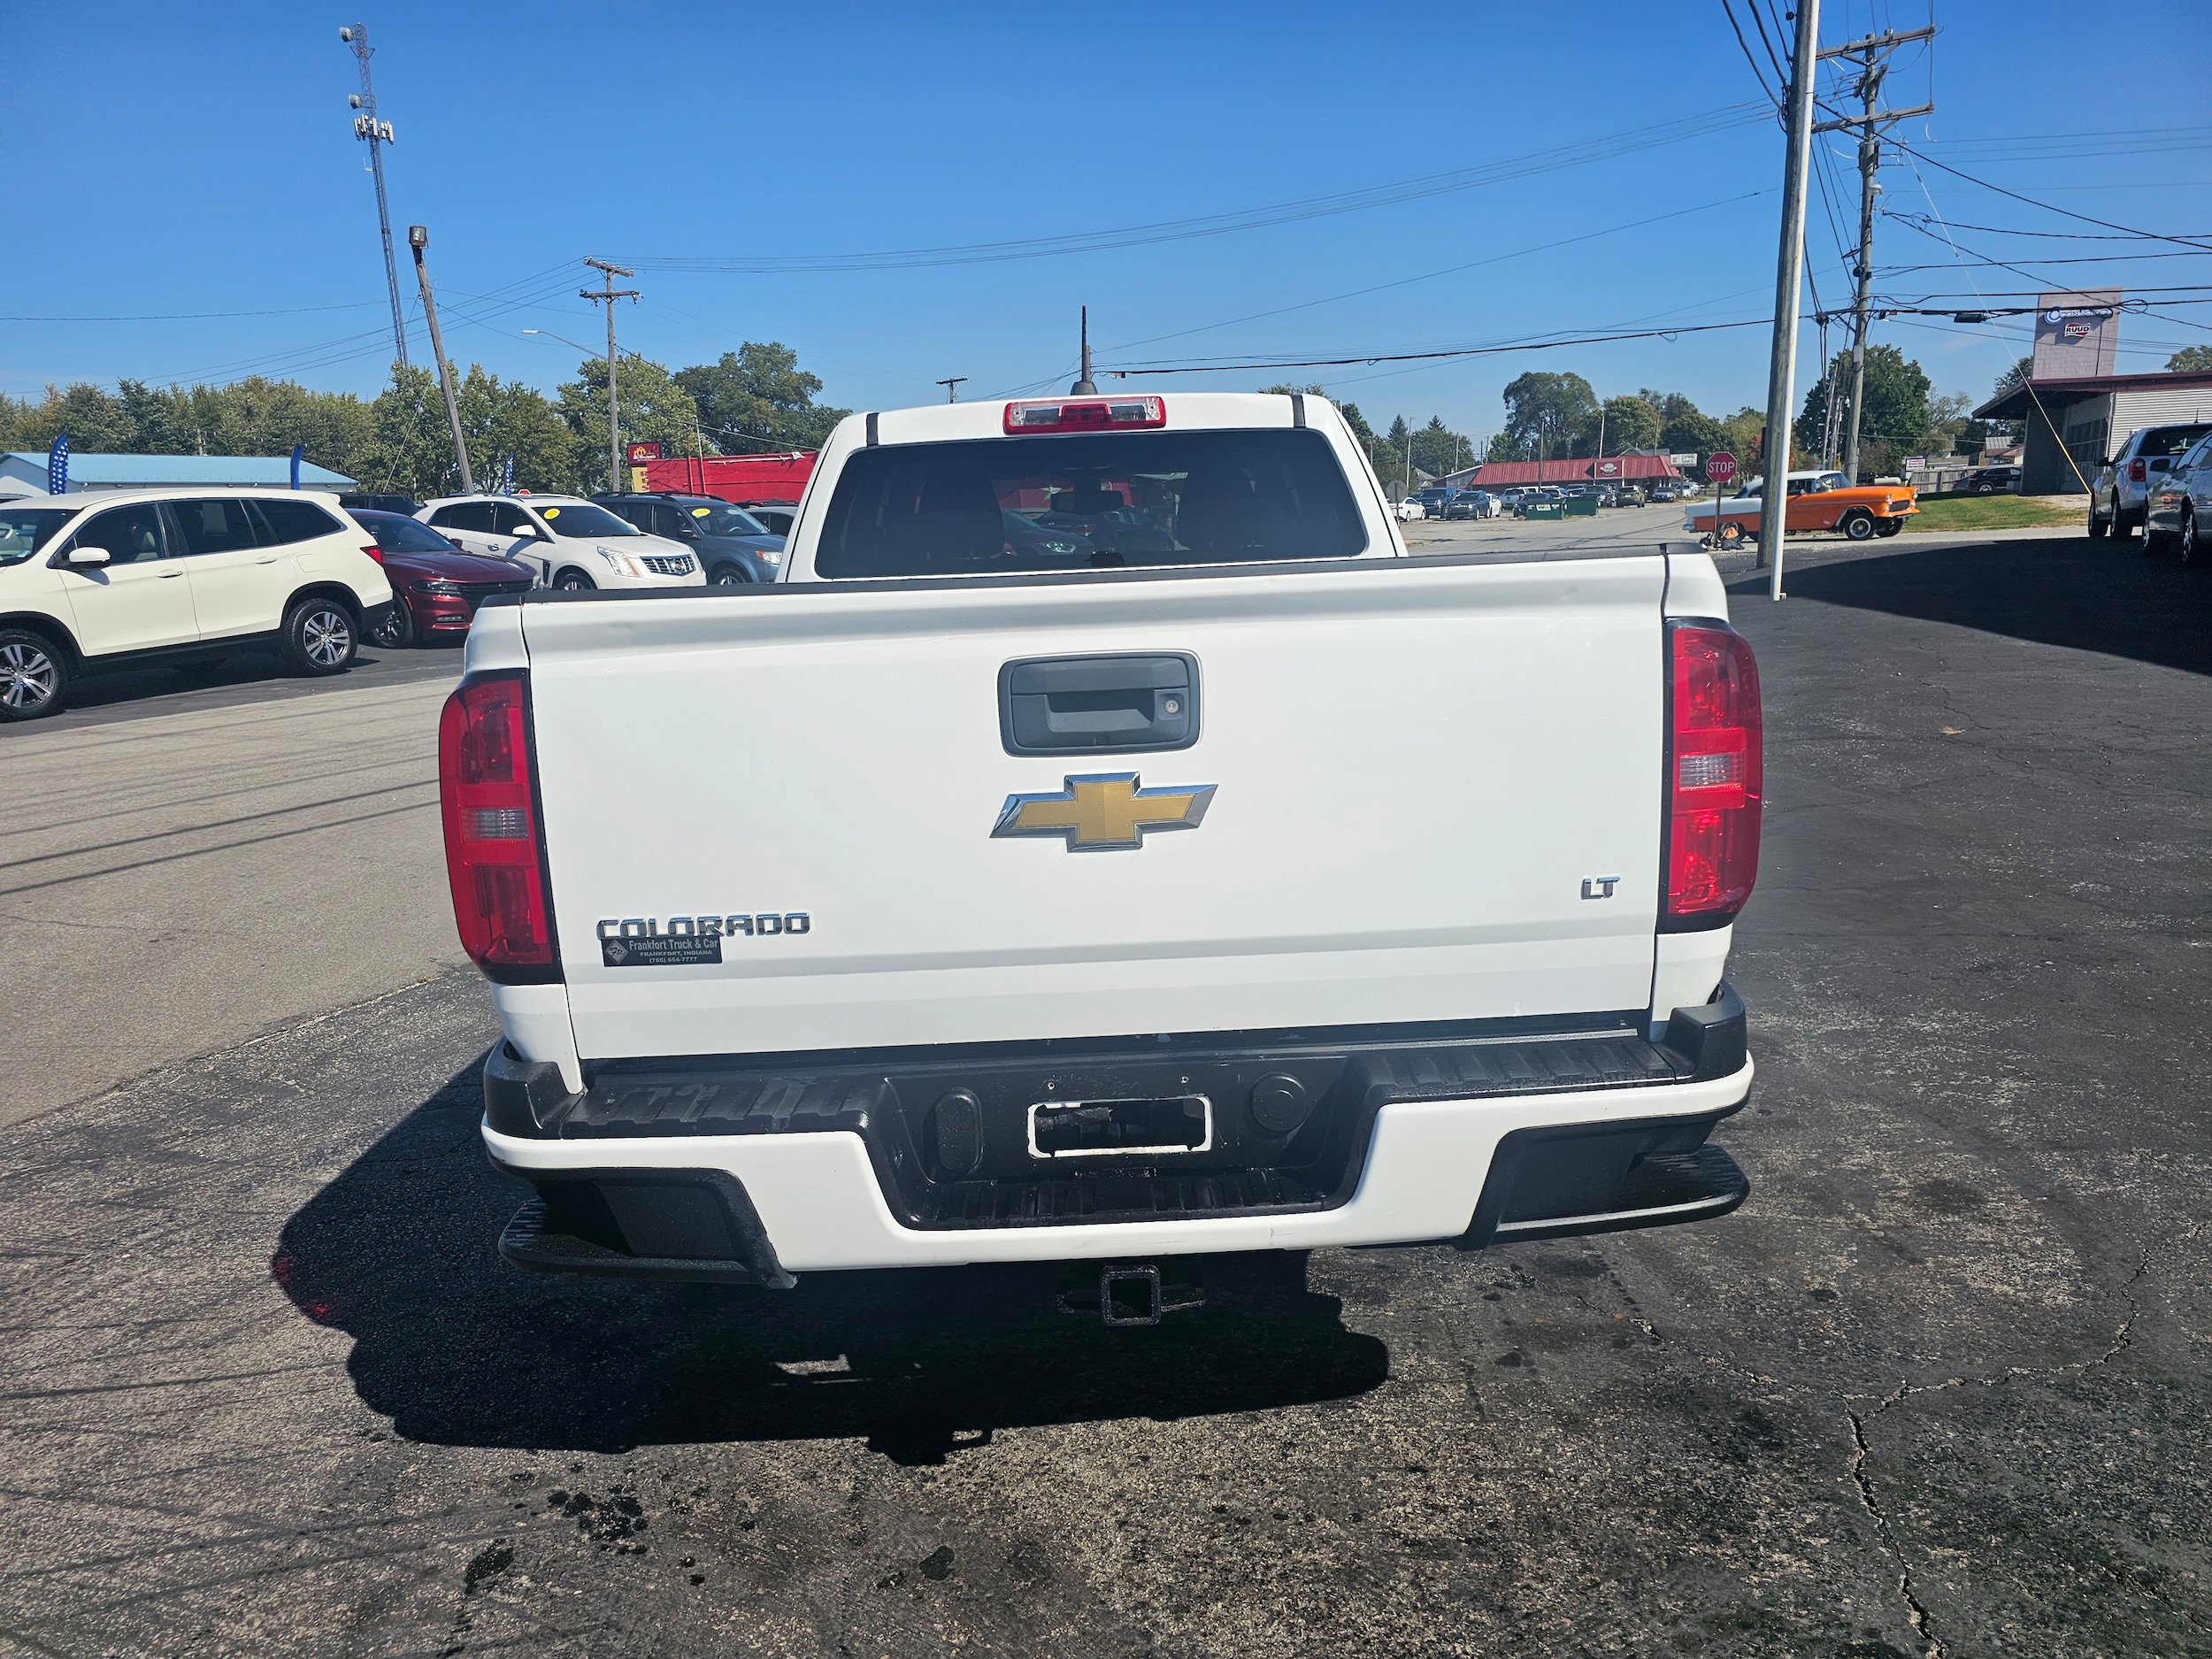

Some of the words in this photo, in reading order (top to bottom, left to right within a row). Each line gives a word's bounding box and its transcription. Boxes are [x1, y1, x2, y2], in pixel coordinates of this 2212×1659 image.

[1708, 462, 1734, 473] STOP
[1581, 877, 1620, 900] LT
[596, 912, 811, 941] COLORADO
[628, 939, 667, 950] Frankfort
[668, 939, 692, 949] Truck
[695, 938, 702, 949] &
[703, 938, 718, 949] Car
